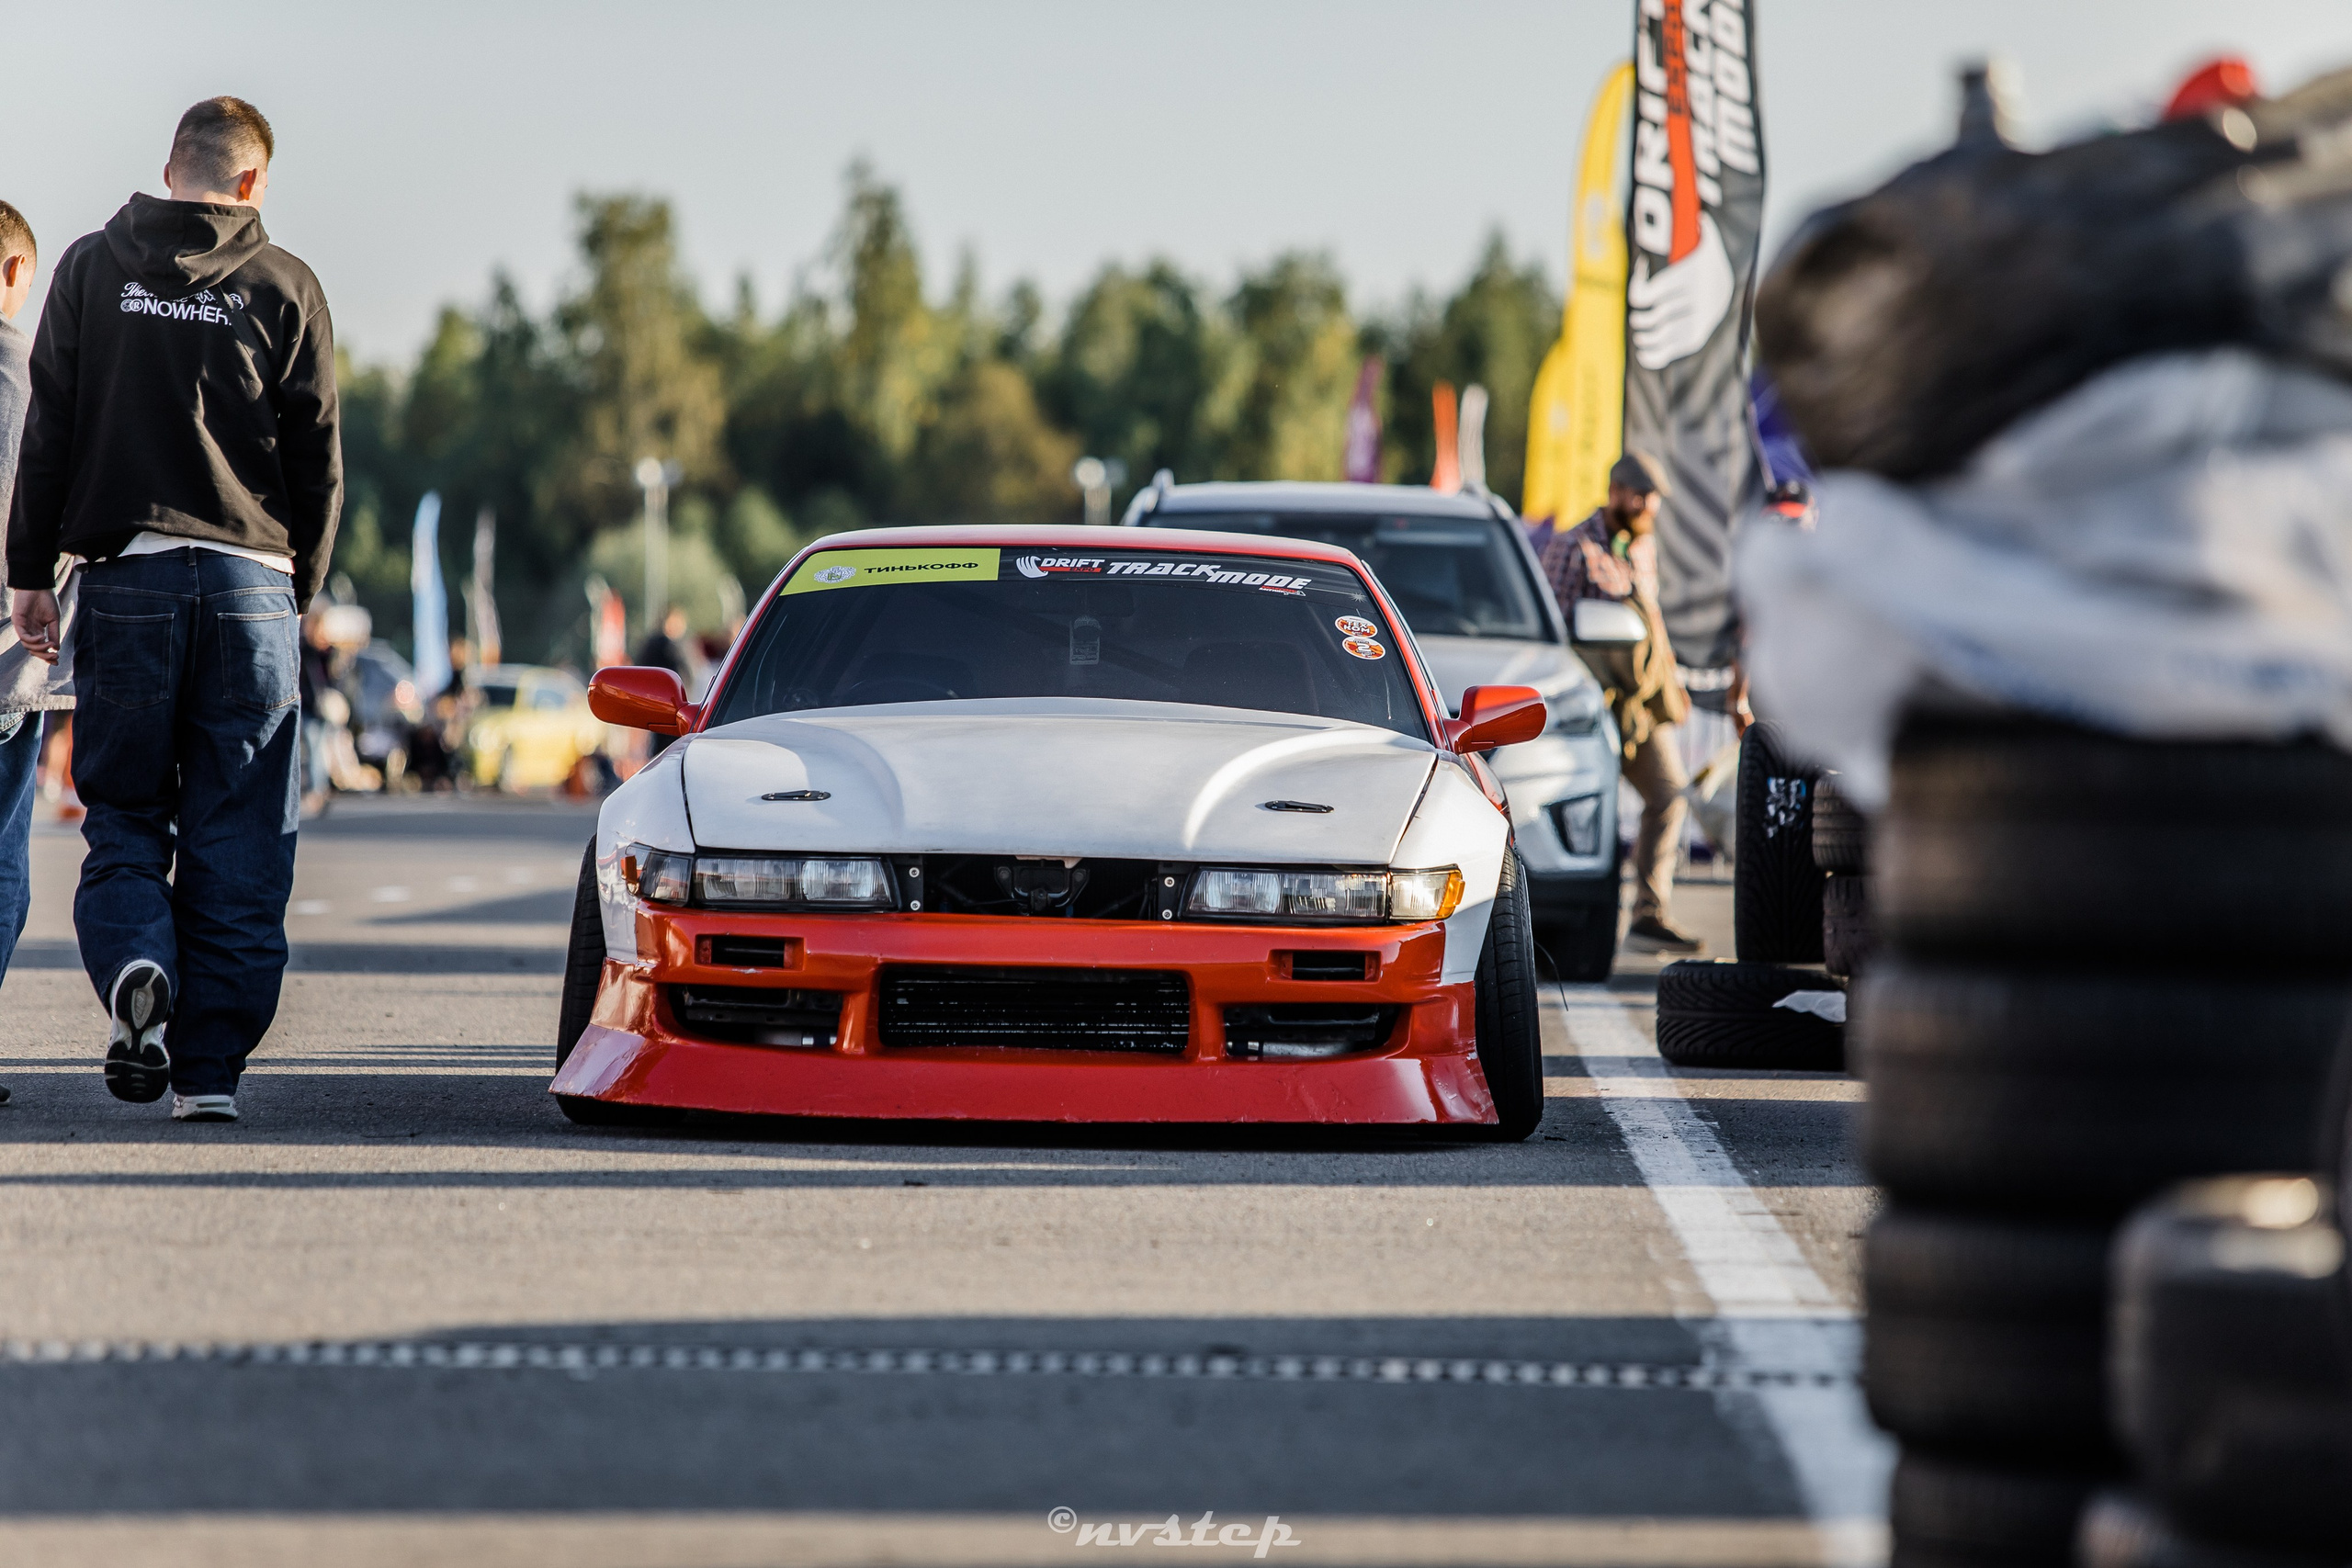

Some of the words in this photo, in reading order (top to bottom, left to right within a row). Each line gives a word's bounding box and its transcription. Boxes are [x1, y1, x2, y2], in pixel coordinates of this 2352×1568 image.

[1708, 0, 1759, 175] MOD
[142, 298, 232, 326] NOWHER
[864, 562, 978, 574] ТИНЬКОФФ
[1040, 558, 1105, 568] DRIFT
